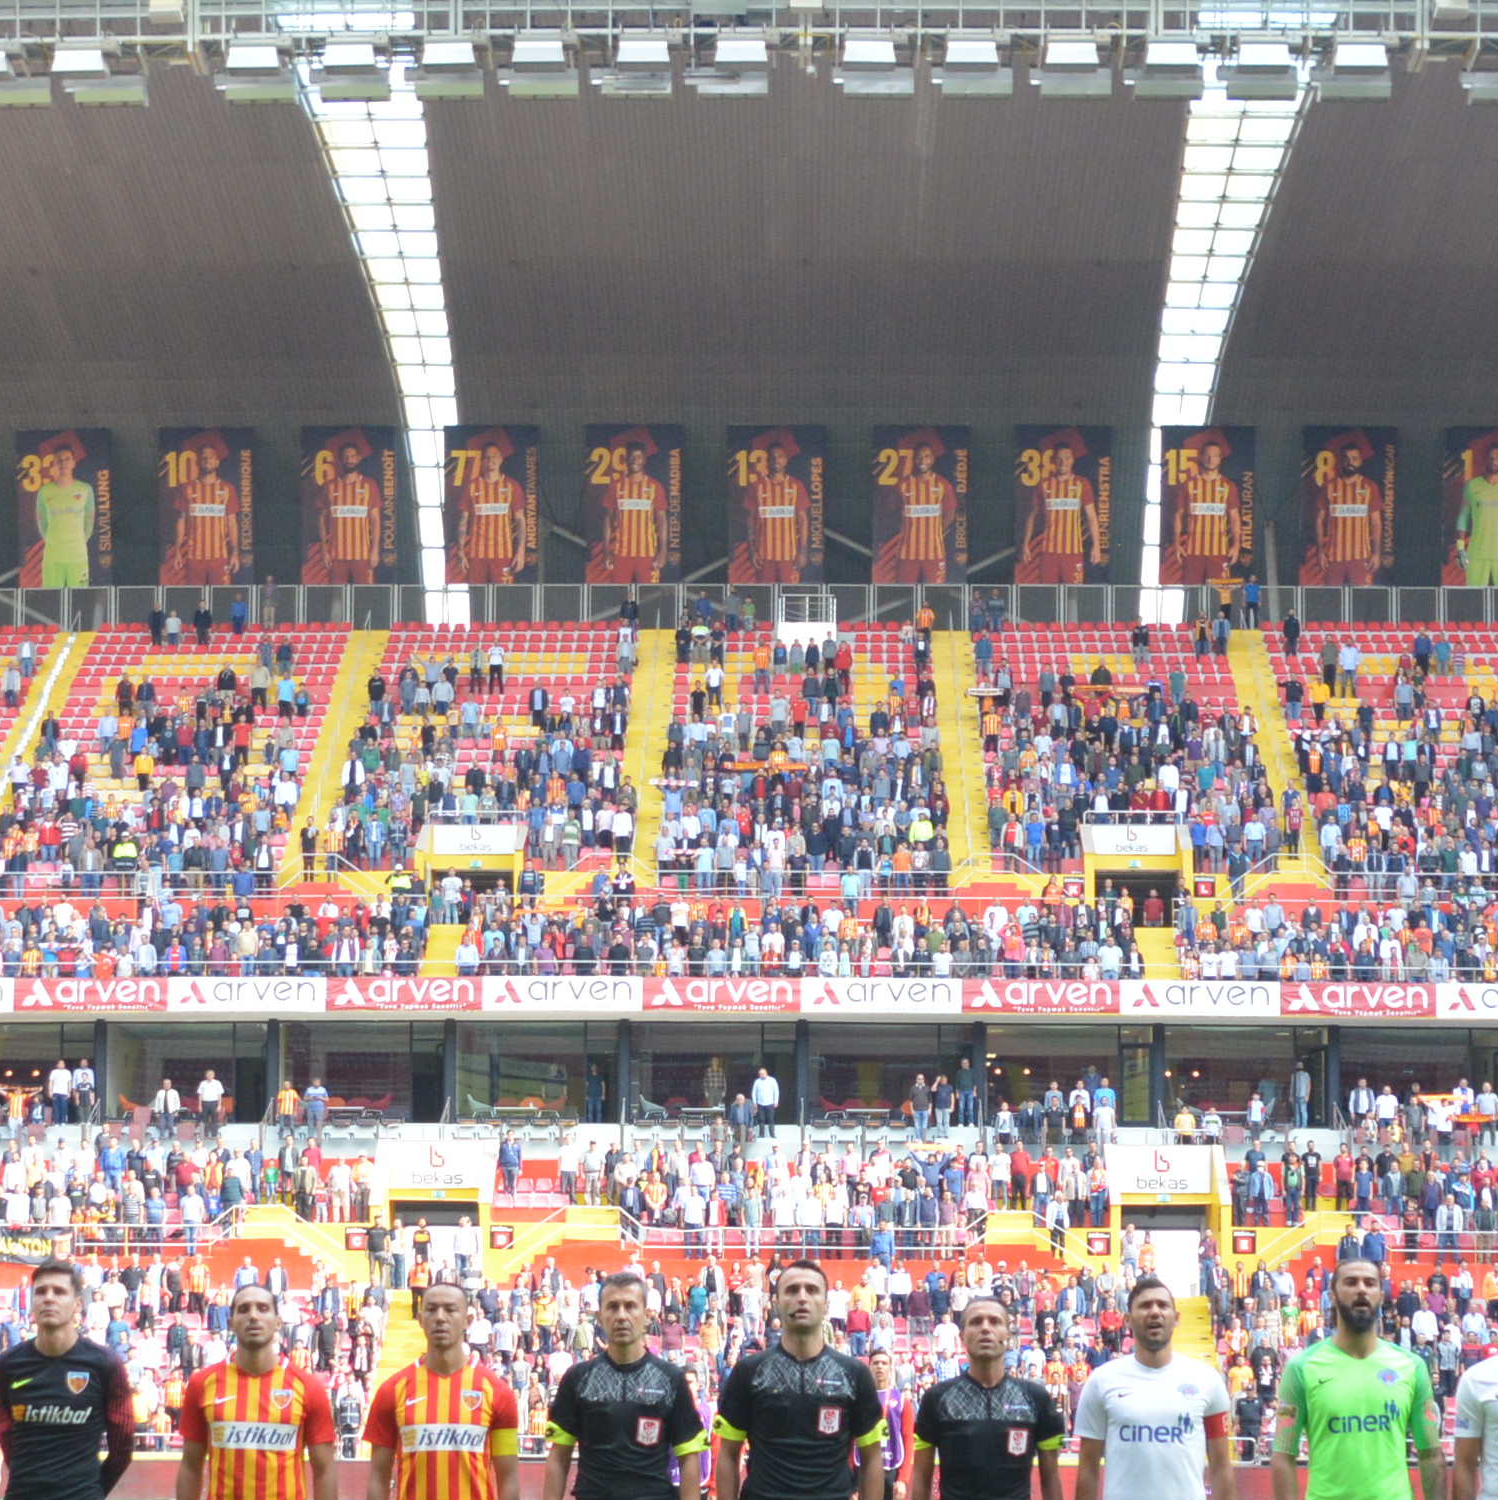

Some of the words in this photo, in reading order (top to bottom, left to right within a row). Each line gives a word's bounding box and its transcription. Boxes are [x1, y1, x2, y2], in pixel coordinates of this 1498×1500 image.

[165, 450, 199, 487] 10
[315, 449, 335, 486] 6
[451, 450, 482, 486] 77
[590, 447, 628, 485] 29
[736, 449, 768, 486] 13
[878, 448, 914, 486] 27
[1165, 449, 1199, 486] 15
[1316, 450, 1335, 487] 8
[1461, 449, 1473, 483] 1
[55, 979, 161, 1004] arven
[213, 980, 316, 1002] arven
[367, 979, 474, 1004] arven
[528, 979, 632, 1002] arven
[686, 979, 793, 1004] arven
[846, 981, 951, 1003] arven
[1005, 981, 1113, 1006] arven
[1165, 984, 1270, 1007] arven
[1321, 985, 1429, 1010] arven
[1136, 1176, 1189, 1192] bekaş
[24, 1404, 94, 1425] istikbal
[226, 1424, 297, 1445] istikbal
[418, 1426, 487, 1447] istikbal
